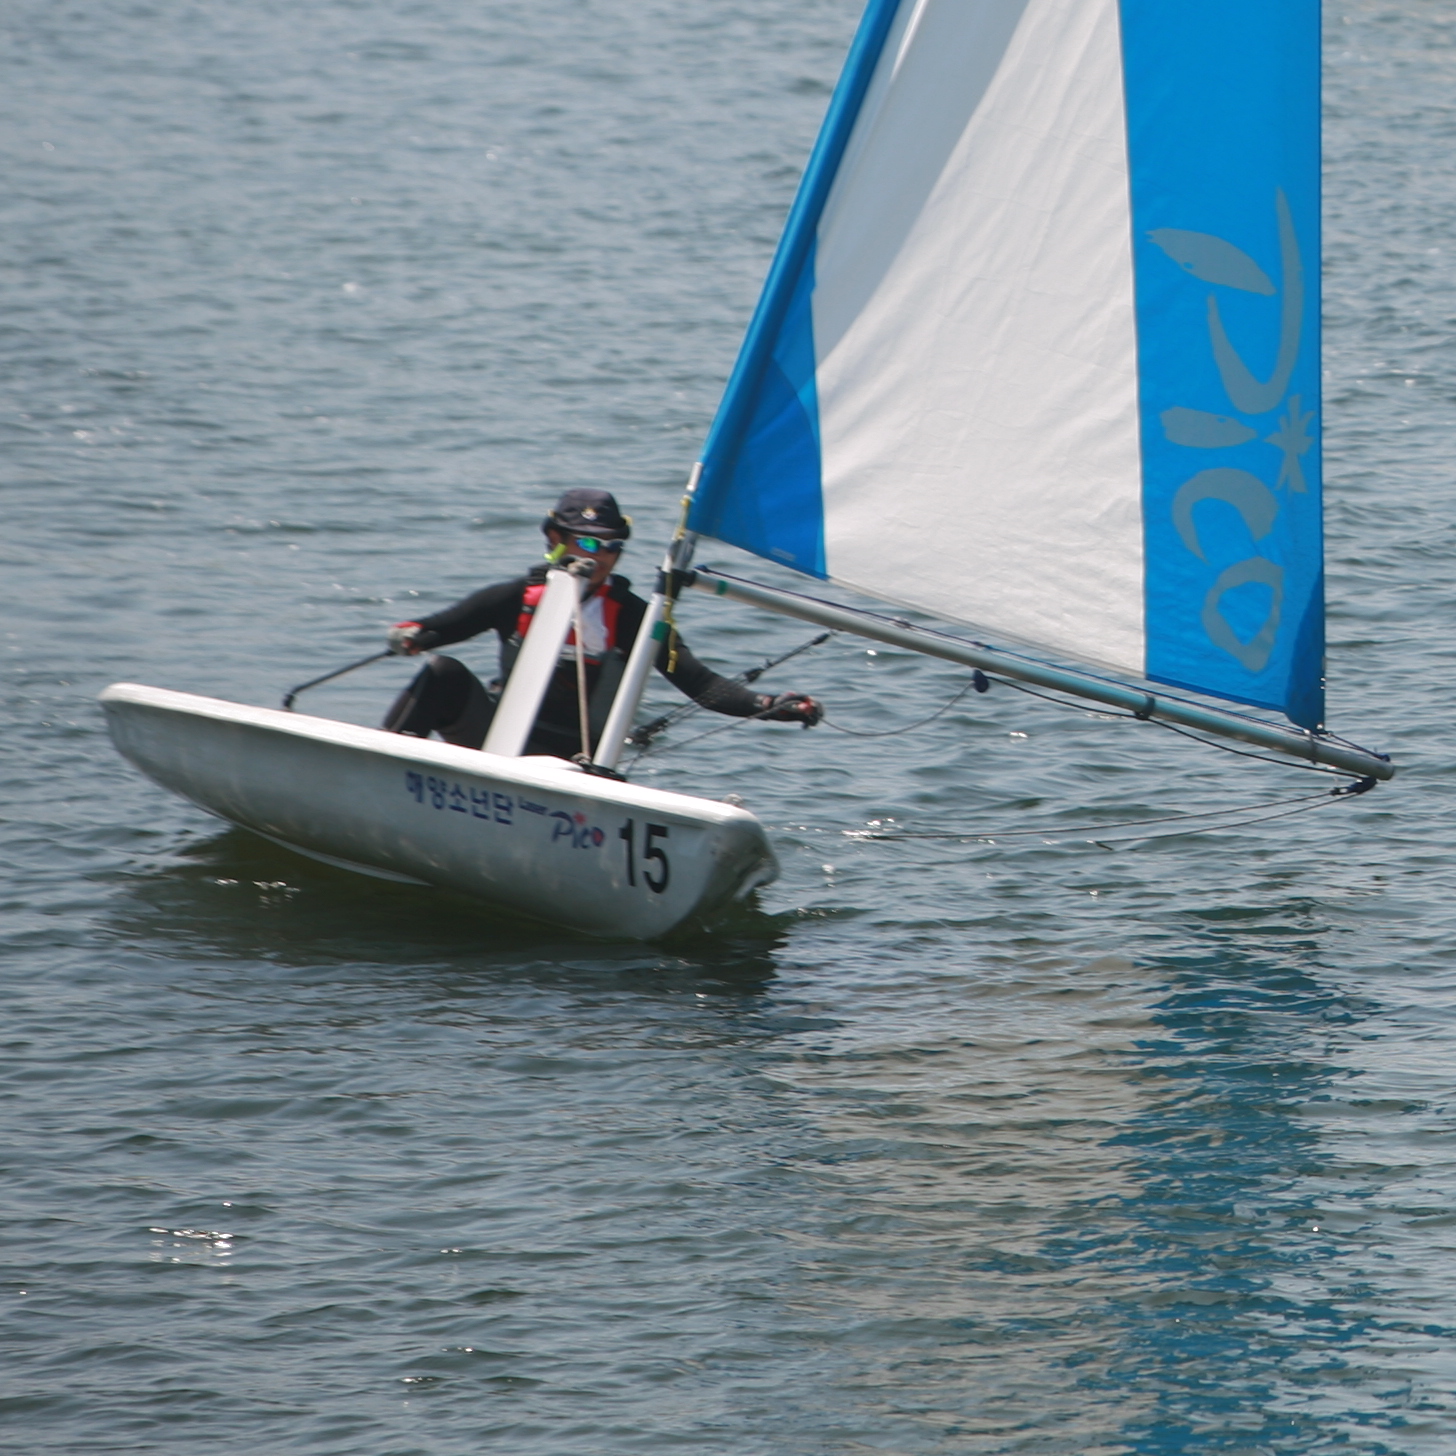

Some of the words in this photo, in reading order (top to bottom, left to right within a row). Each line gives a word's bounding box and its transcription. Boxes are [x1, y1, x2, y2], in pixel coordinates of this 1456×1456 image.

[1145, 187, 1316, 673] Pico
[549, 809, 605, 850] Pico
[618, 817, 670, 894] 15
